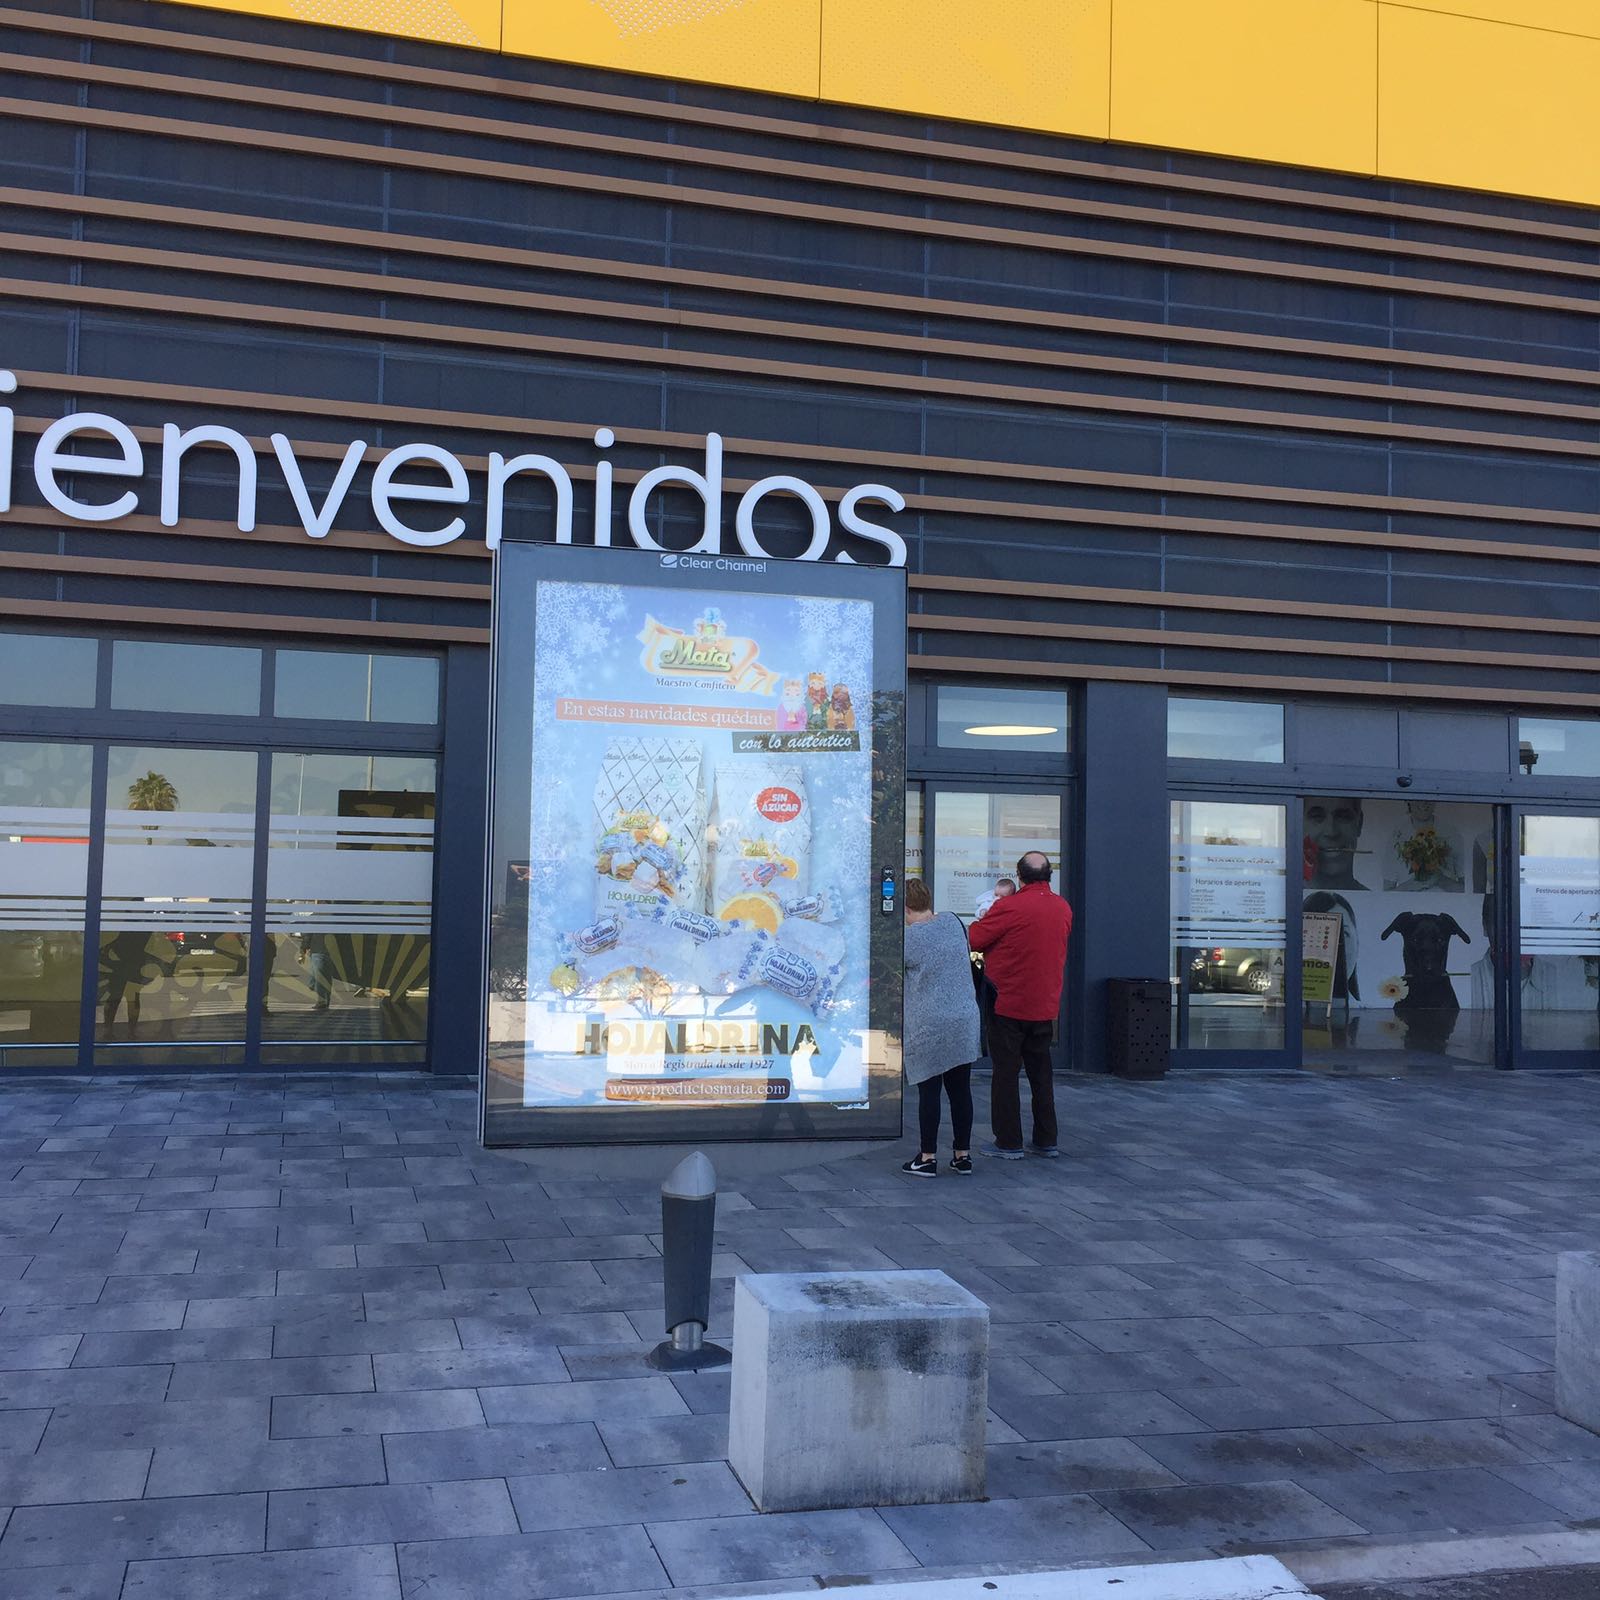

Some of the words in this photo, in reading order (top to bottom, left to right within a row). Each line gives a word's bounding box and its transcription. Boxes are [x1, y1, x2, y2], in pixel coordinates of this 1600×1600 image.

[680, 556, 713, 569] Clear
[716, 558, 767, 573] Channel
[659, 639, 733, 671] Mata
[655, 678, 692, 688] Maestro
[694, 680, 736, 691] Confitero
[563, 701, 583, 716] En
[588, 704, 625, 719] estas
[629, 706, 707, 724] navidades
[711, 708, 772, 729] quédate
[739, 738, 763, 750] con
[768, 733, 782, 750] lo
[787, 732, 852, 749] auténtico
[772, 793, 788, 802] SIN
[953, 870, 982, 878] Festivos
[575, 1022, 821, 1056] HOJALDRINA
[660, 1059, 713, 1072] Registrada
[715, 1059, 746, 1069] desde
[749, 1059, 774, 1070] 1927
[608, 1081, 787, 1100] www.productosmata.com
